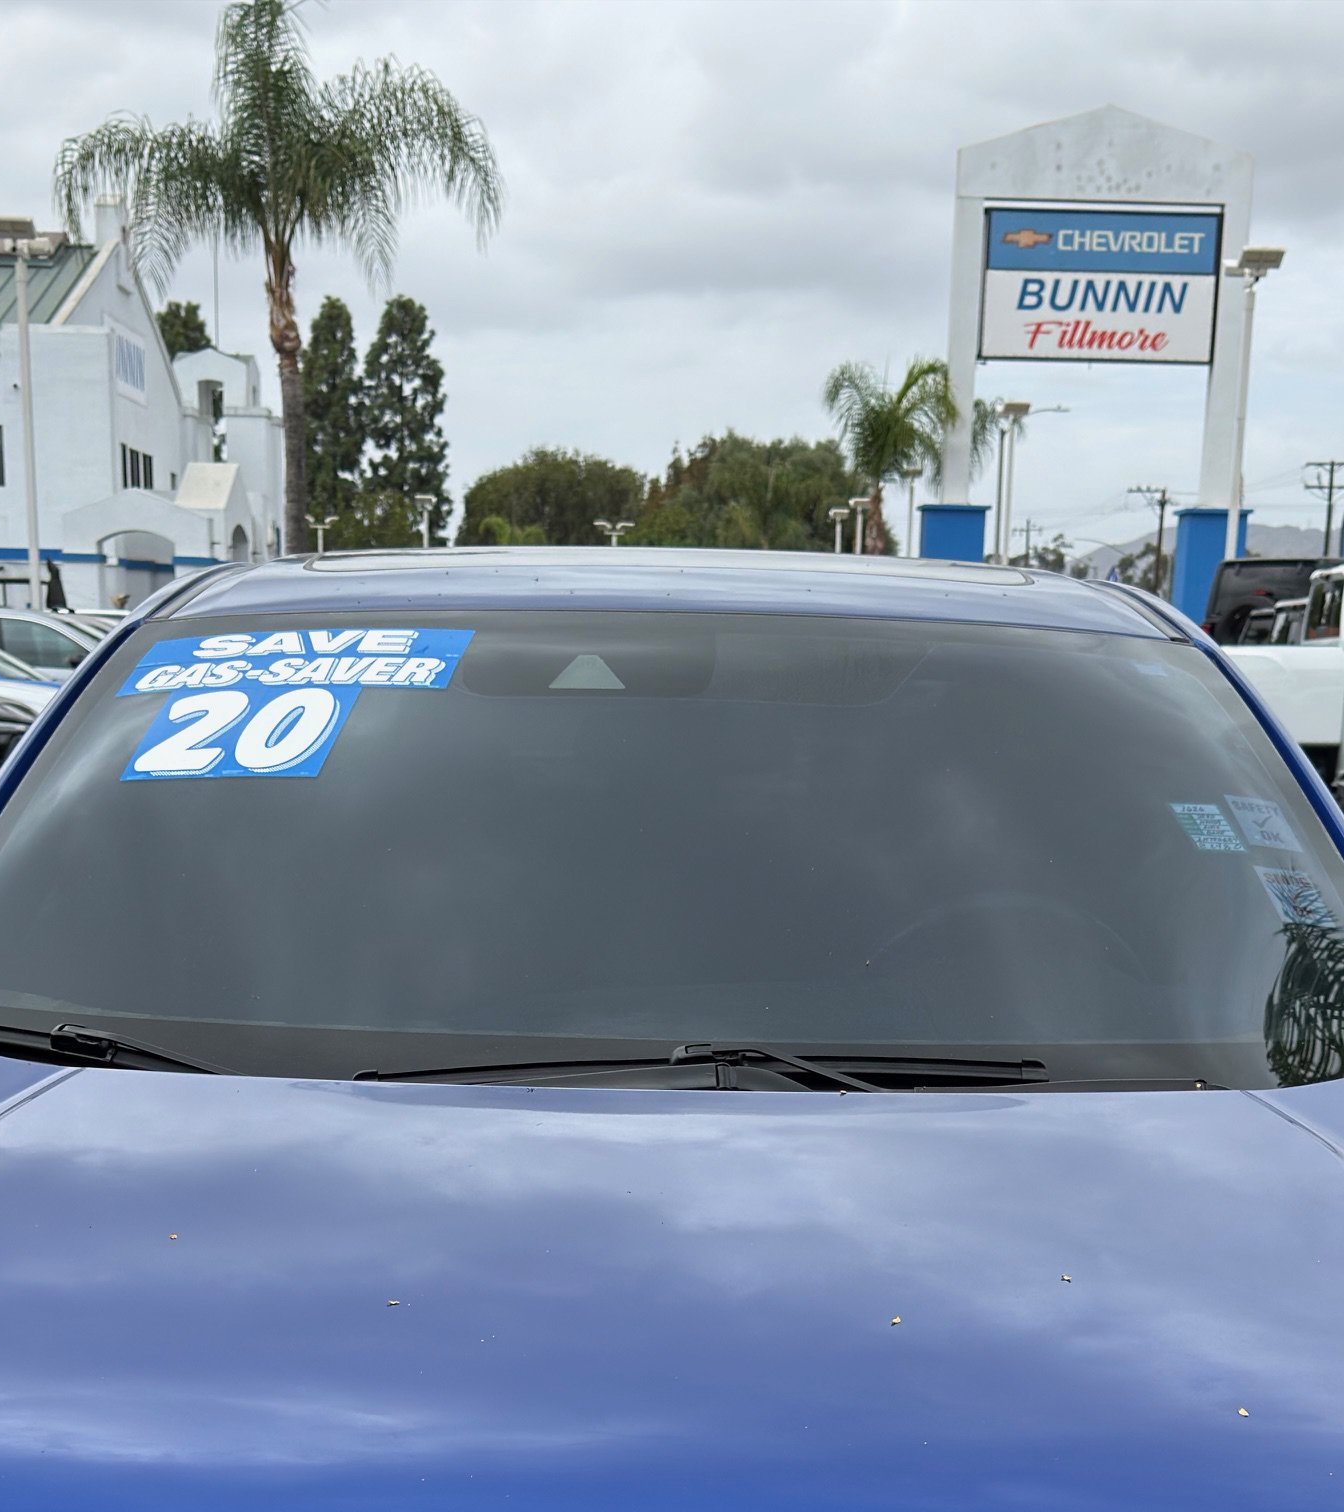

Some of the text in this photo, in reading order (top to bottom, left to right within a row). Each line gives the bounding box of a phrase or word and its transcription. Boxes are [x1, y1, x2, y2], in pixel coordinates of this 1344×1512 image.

[1057, 229, 1205, 254] CHEVROLET
[1017, 278, 1189, 314] BUNNIN
[1024, 320, 1169, 352] Fillmore
[193, 630, 419, 659] SAVE
[134, 657, 447, 691] GAS-SAVER
[134, 687, 340, 776] 20
